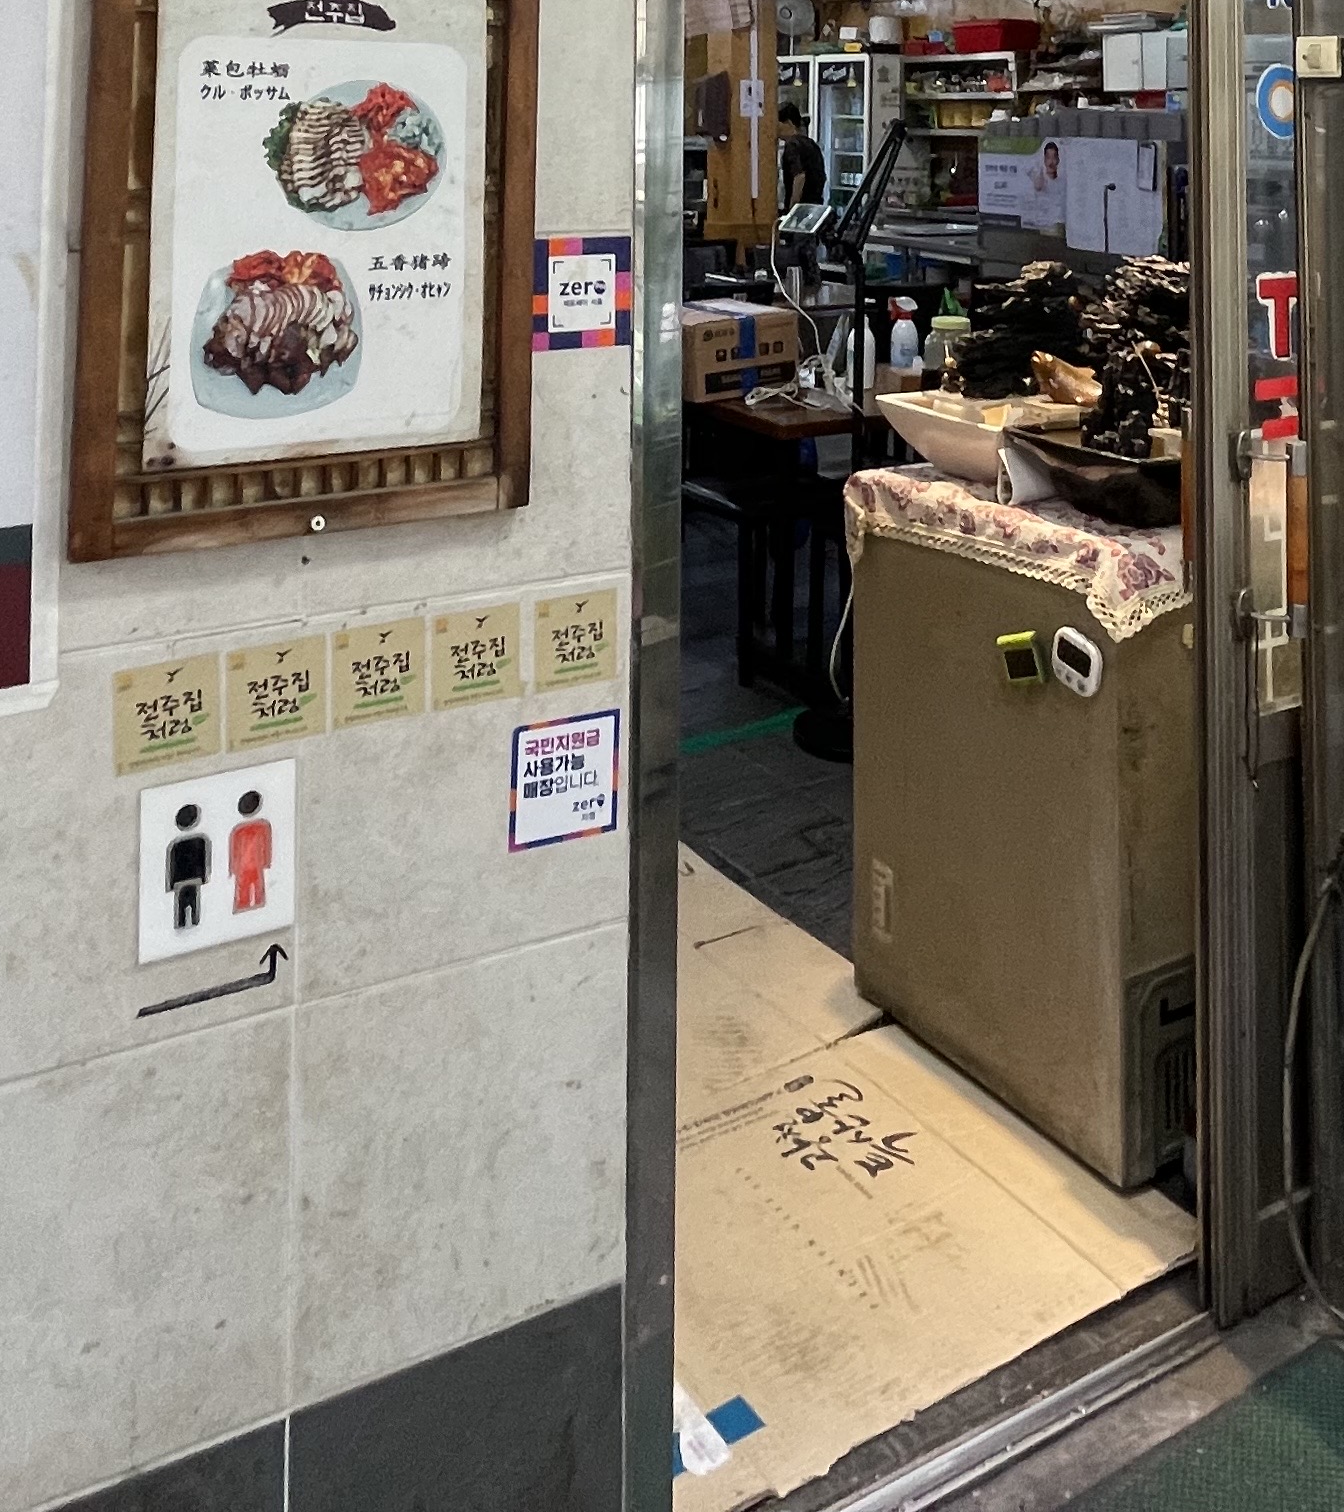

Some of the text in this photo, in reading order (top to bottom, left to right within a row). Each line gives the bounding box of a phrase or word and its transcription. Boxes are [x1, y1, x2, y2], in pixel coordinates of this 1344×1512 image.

[304, 0, 365, 24] 전주집
[558, 279, 607, 297] zero
[550, 619, 604, 647] 전주집
[450, 635, 506, 664] 전주집
[351, 650, 411, 680] 전주집
[246, 669, 310, 702] 전주집
[135, 688, 203, 724] 전주집
[524, 727, 600, 757] 국민지원금
[523, 752, 585, 778] 사용가능
